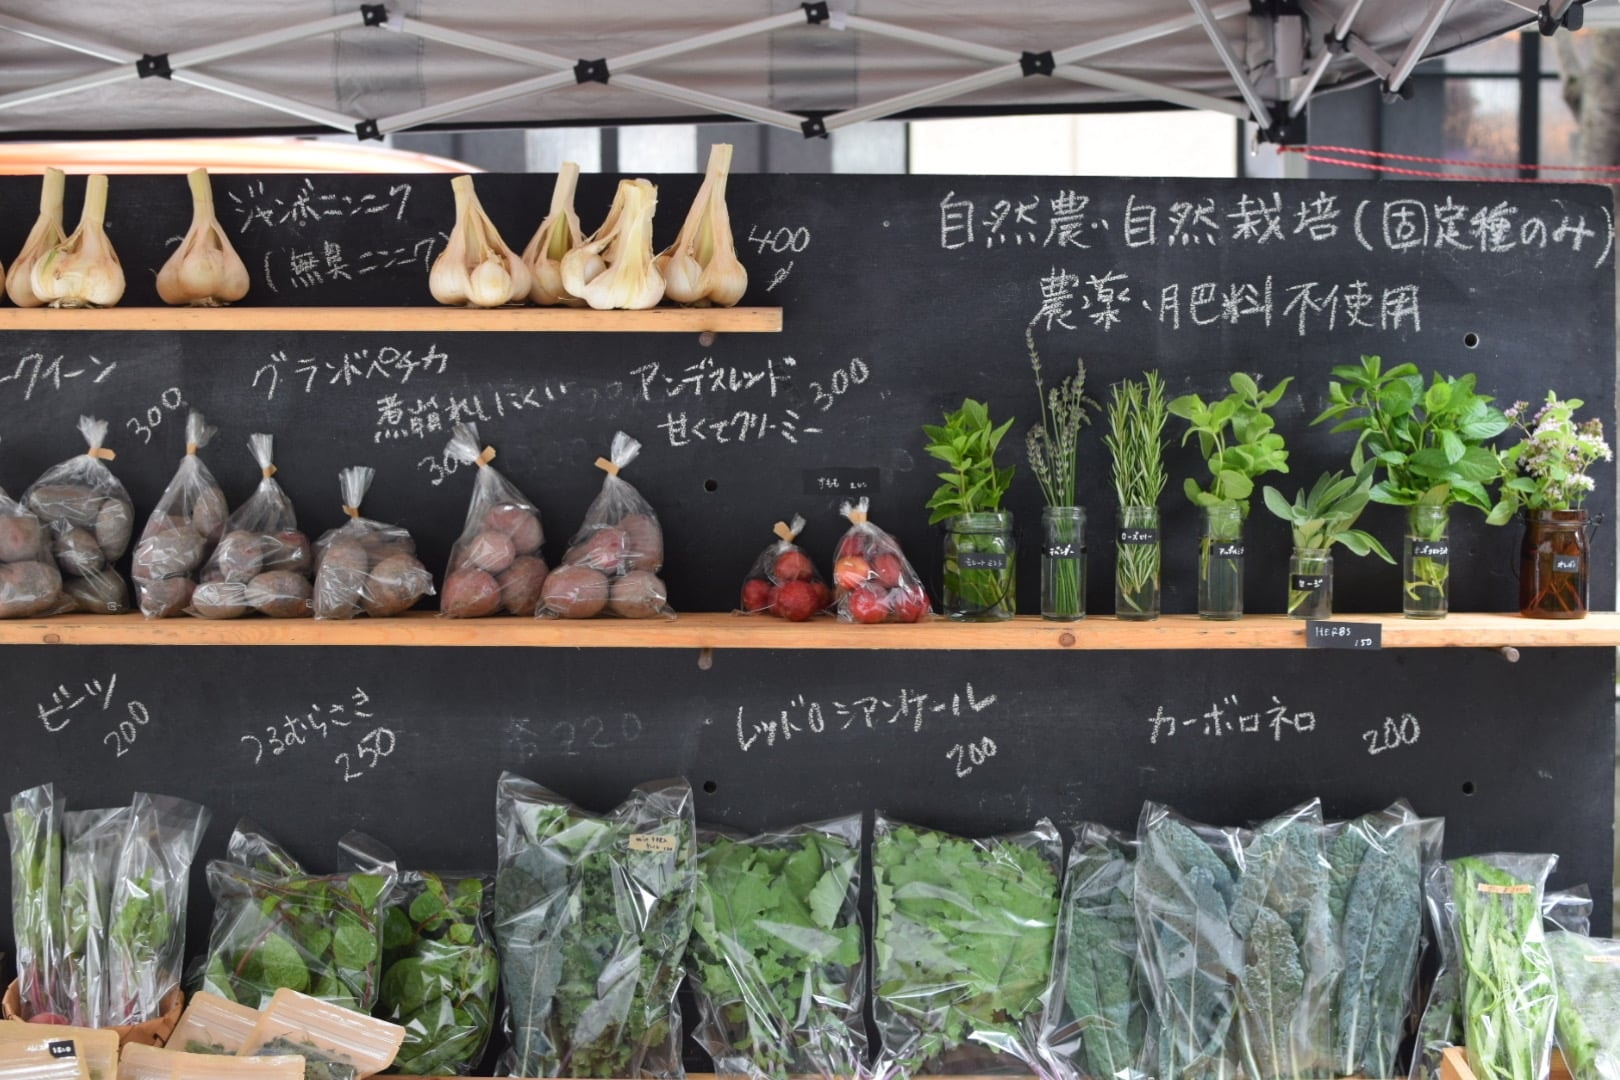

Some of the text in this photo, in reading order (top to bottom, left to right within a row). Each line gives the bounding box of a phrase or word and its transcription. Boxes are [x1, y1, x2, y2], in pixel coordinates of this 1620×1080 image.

[229, 178, 412, 232] ジャンボニンニク
[748, 225, 811, 254] 400
[252, 344, 448, 400] グランドペチカ
[630, 355, 797, 400] アンデスレッド
[808, 357, 870, 412] 300
[126, 387, 182, 444] 300
[657, 409, 824, 447] 甘くてクリーミー
[1298, 578, 1324, 589] セージ
[1315, 626, 1352, 637] HERBS
[1354, 638, 1373, 647] 150
[38, 673, 117, 732] ビーツ
[241, 687, 375, 765] つるむらさき
[1149, 694, 1317, 745] カーボロネロ
[104, 700, 149, 758] 200
[335, 727, 396, 782] 250
[1362, 712, 1421, 755] 200
[946, 736, 998, 778] 200
